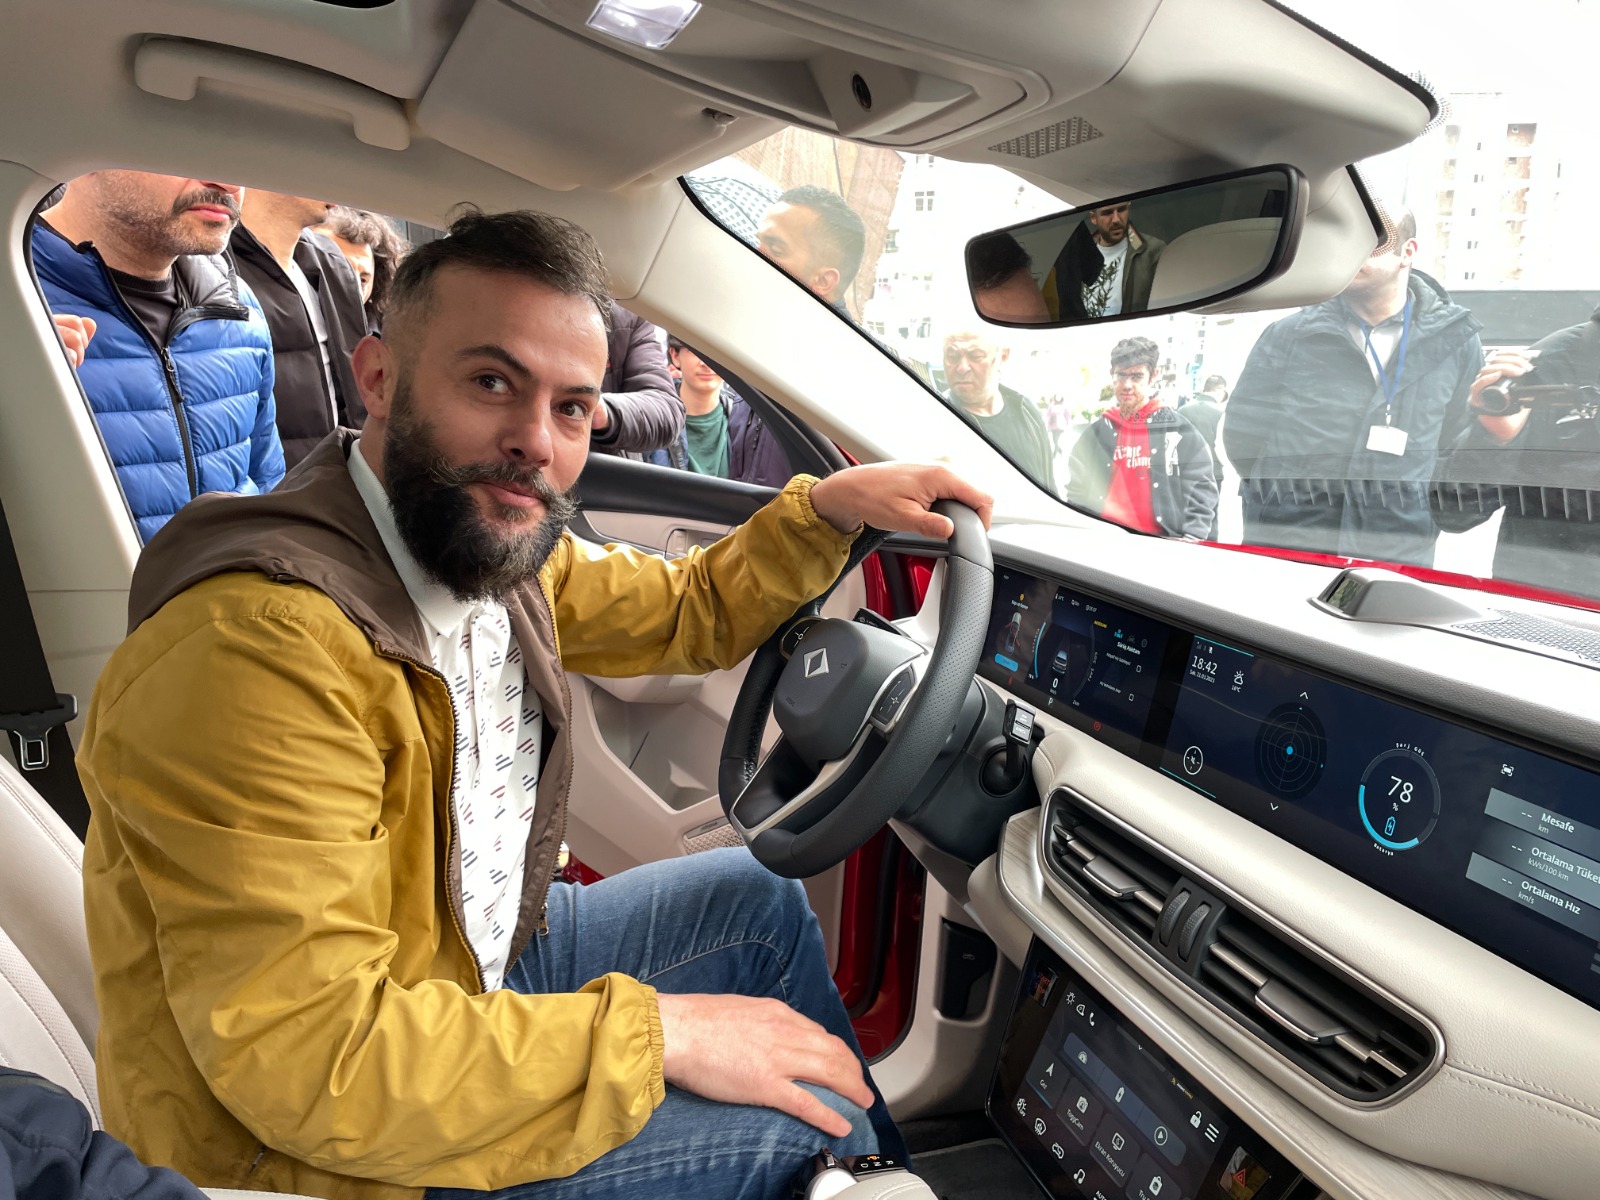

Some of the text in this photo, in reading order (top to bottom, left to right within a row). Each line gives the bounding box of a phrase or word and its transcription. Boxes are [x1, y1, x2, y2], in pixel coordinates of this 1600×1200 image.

[1191, 655, 1218, 675] 18:42
[1387, 775, 1414, 803] 78
[1392, 802, 1399, 812] %
[1537, 823, 1550, 834] km
[1541, 812, 1575, 833] Mesafe
[1531, 847, 1574, 872] Ortalama
[1558, 870, 1569, 881] km
[1517, 891, 1535, 905] km/s
[1521, 880, 1581, 915] Ortalama Hız
